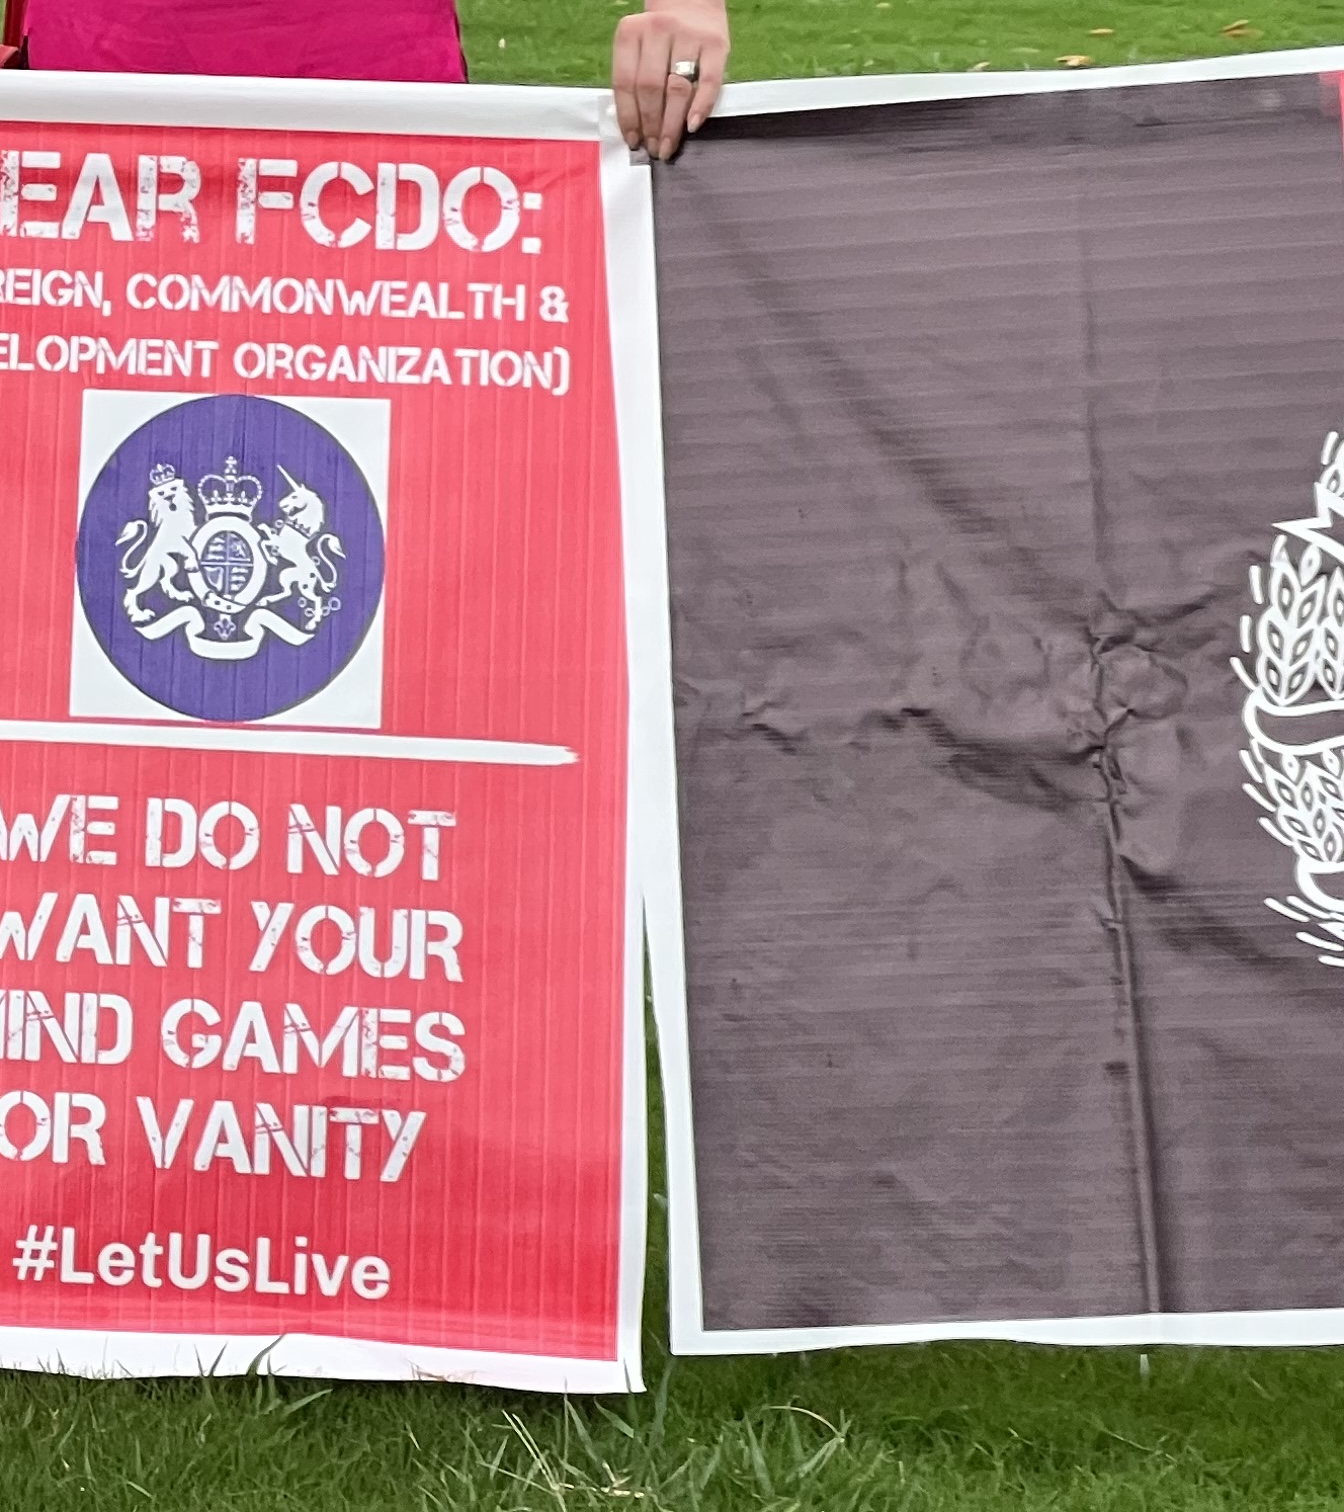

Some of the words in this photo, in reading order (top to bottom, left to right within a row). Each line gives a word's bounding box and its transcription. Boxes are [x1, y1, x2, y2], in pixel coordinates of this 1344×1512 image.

[235, 157, 544, 255] FCDO:
[125, 272, 527, 322] COMMONWEALTH
[538, 285, 569, 324] &
[232, 341, 571, 395] ORGANIZATION)
[144, 797, 261, 871] DO
[286, 803, 457, 881] NOT
[248, 900, 464, 983] YOUR
[160, 998, 466, 1083] GAMES
[136, 1095, 427, 1182] VANITY
[12, 1224, 390, 1300] #LetUsLive
